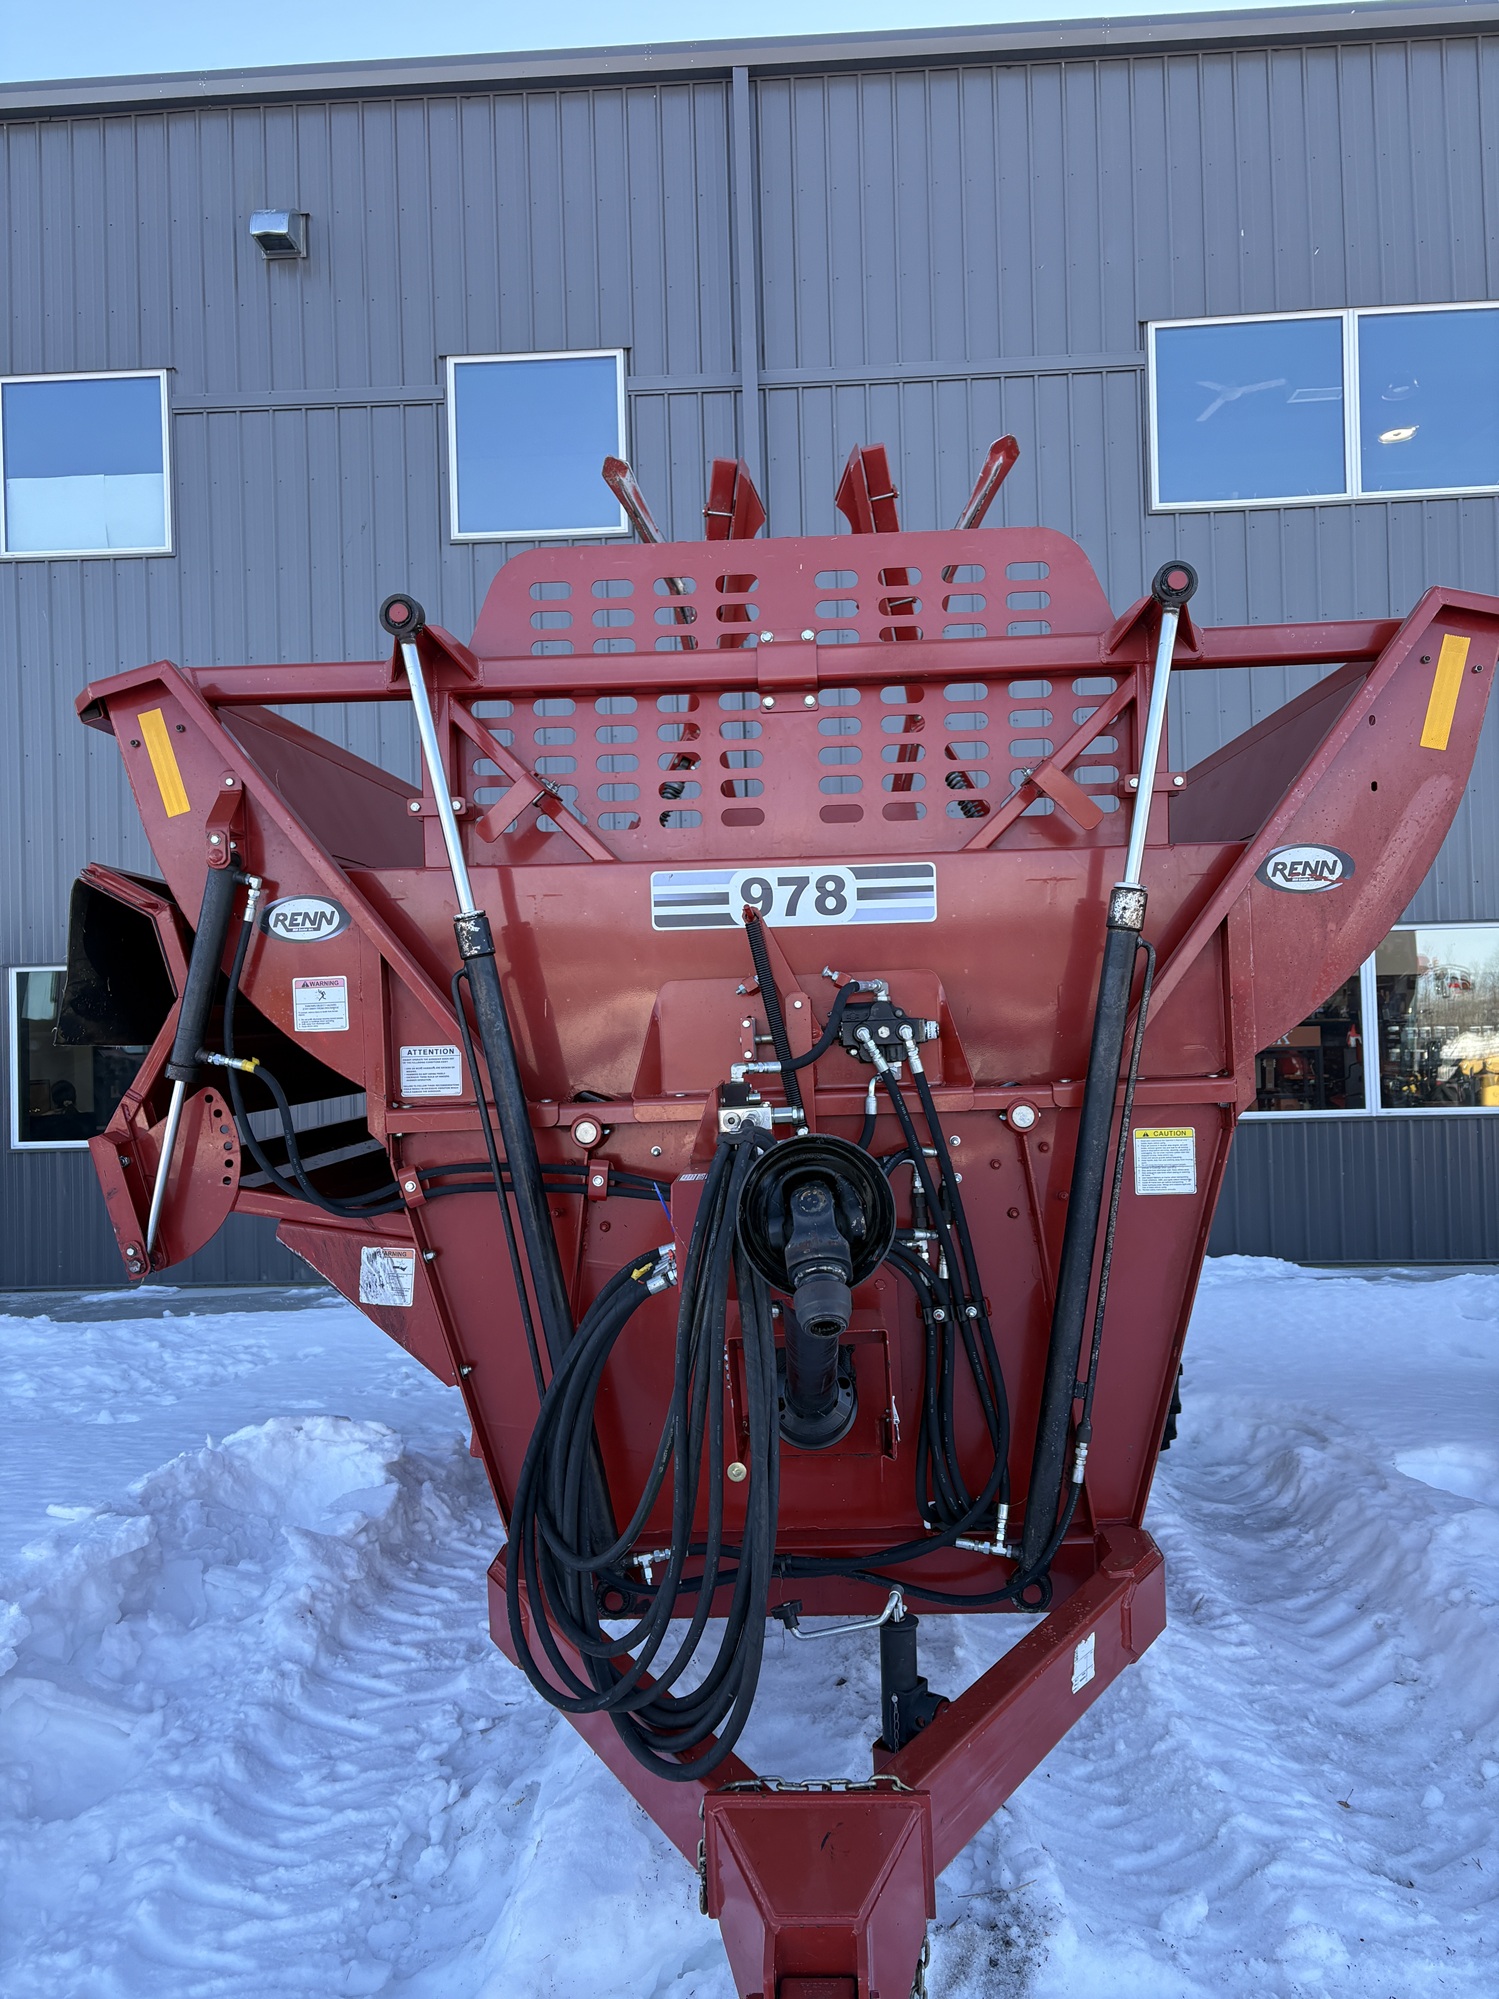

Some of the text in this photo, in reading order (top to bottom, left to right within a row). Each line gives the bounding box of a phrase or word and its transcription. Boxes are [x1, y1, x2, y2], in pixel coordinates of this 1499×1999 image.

[1271, 860, 1338, 882] RENN
[740, 875, 848, 919] 978
[273, 910, 335, 932] RENN
[407, 1048, 455, 1056] ATTENTION
